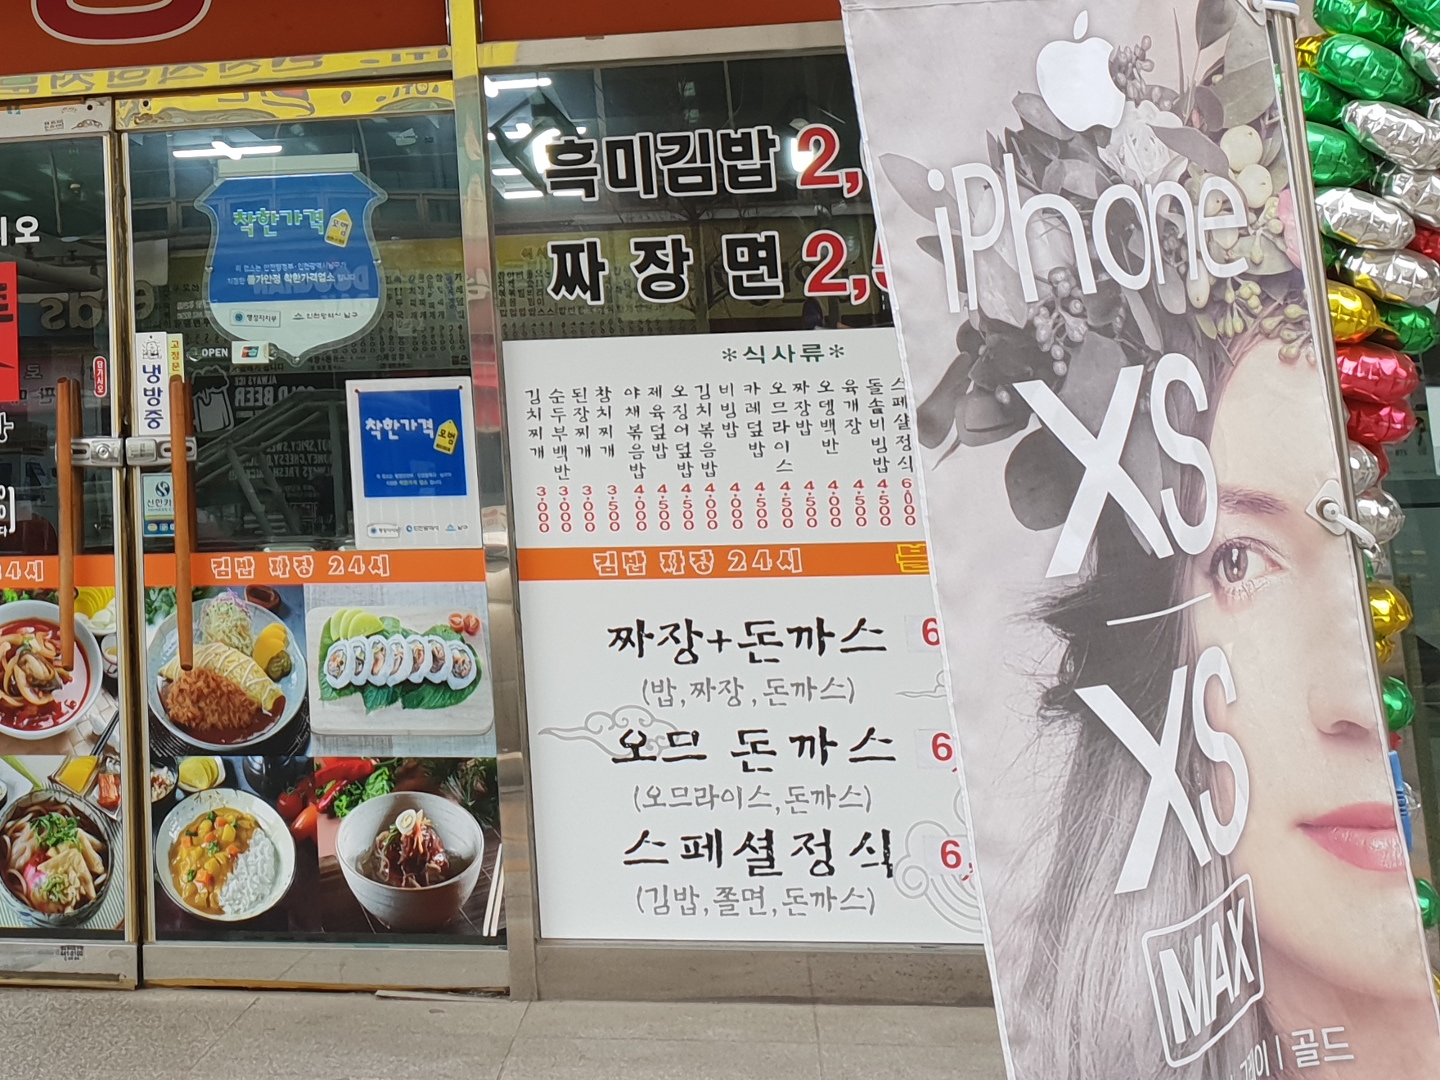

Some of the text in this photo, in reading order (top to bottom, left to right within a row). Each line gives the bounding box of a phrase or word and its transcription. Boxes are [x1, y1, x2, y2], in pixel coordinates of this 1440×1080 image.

[544, 125, 780, 202] 흑미김밥
[232, 207, 325, 238] 착한가격
[926, 152, 1250, 314] iPhone
[201, 348, 229, 358] OPEN
[142, 363, 164, 430] 냉방중
[365, 417, 435, 441] 착한가격
[1012, 352, 1217, 579] XS
[327, 553, 390, 577] 24시
[727, 547, 802, 573] 24시
[611, 726, 896, 773] 오므 돈까스
[1074, 645, 1250, 895] XS
[623, 828, 895, 878] 스페셜정식
[1158, 897, 1256, 1044] MAX
[1291, 1026, 1355, 1068] 골드
